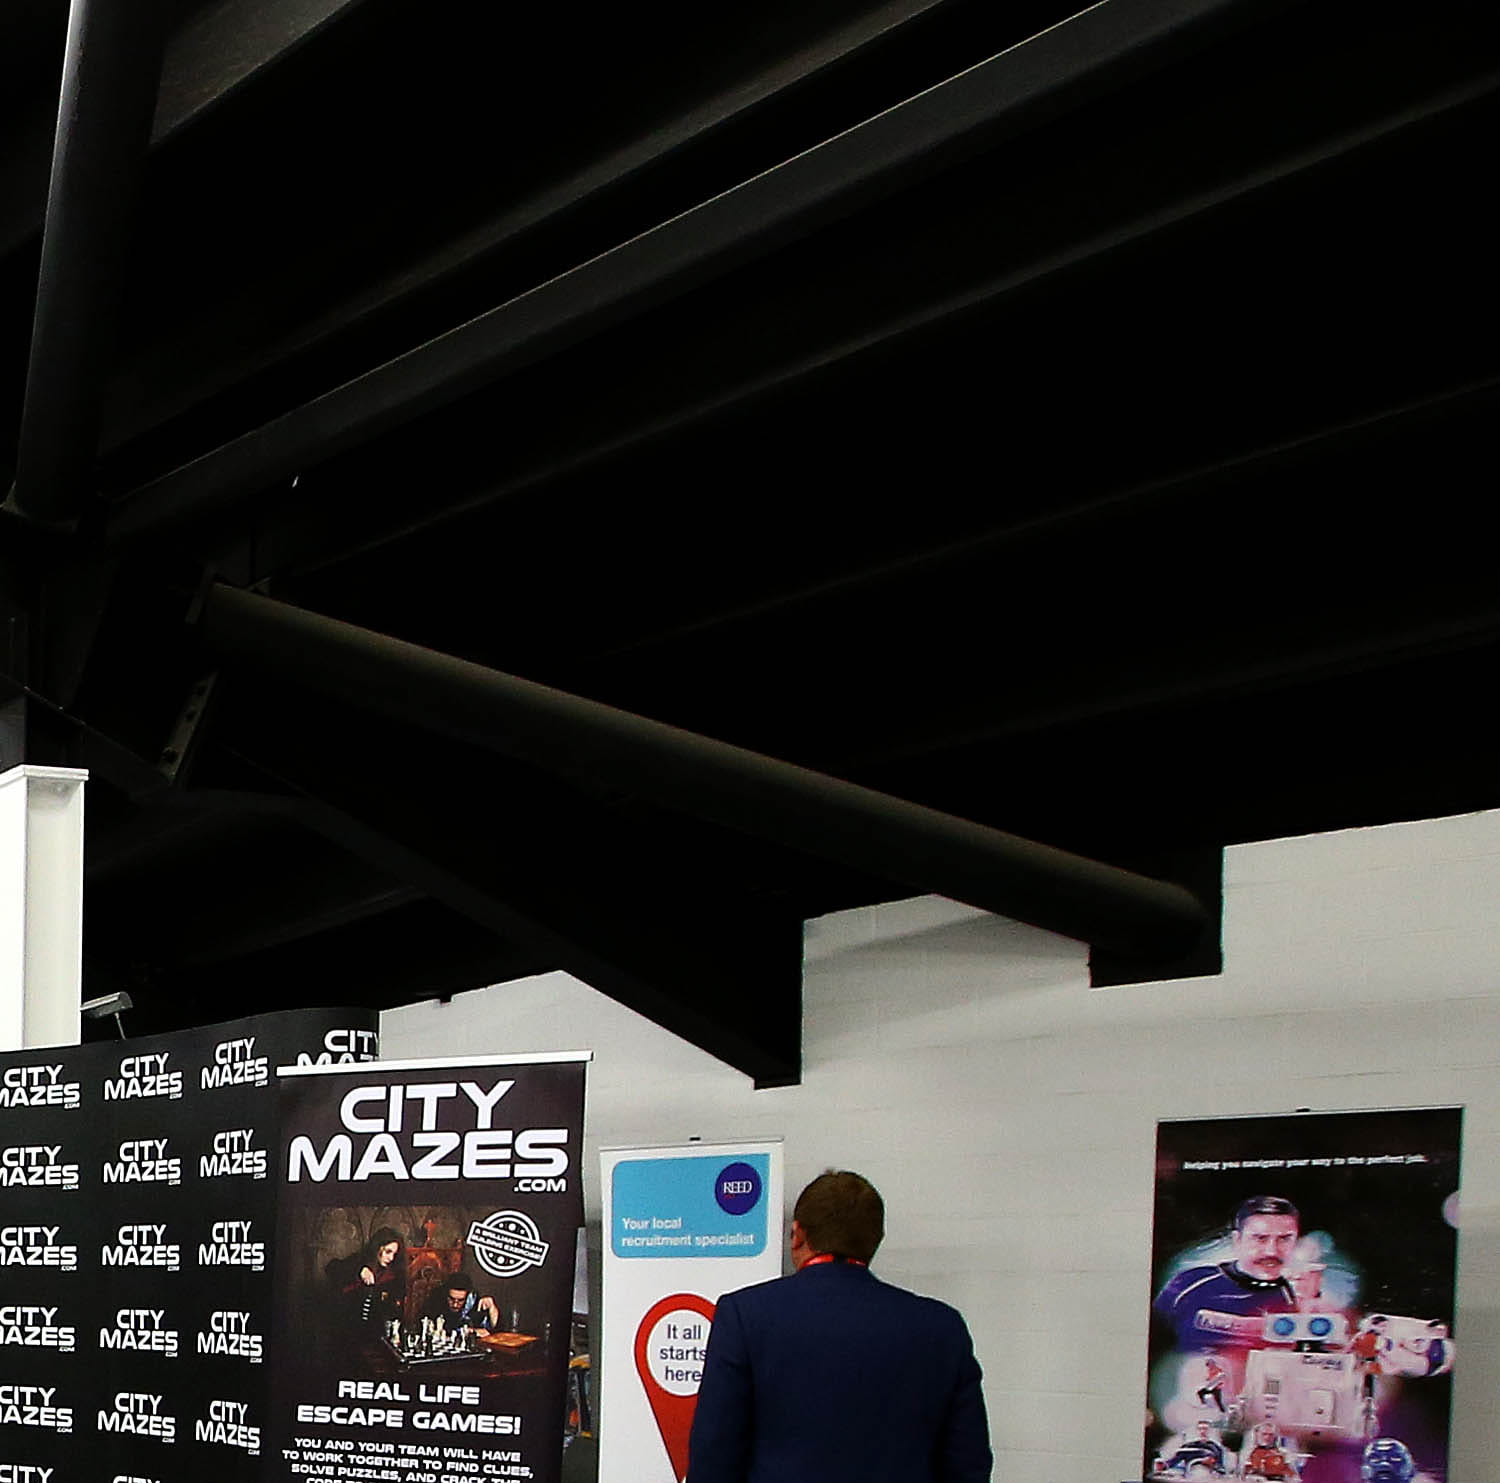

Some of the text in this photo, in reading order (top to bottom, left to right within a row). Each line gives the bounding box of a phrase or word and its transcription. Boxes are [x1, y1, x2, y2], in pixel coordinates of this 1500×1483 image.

[4, 1065, 62, 1087] CITY
[340, 1079, 516, 1134] CITY
[288, 1128, 569, 1182] MAZES
[1222, 1160, 1241, 1170] you
[1286, 1158, 1309, 1168] your
[1311, 1157, 1332, 1167] way
[1333, 1156, 1345, 1165] to
[1347, 1155, 1365, 1164] the
[1367, 1154, 1404, 1166] perfect
[513, 1178, 567, 1193] .COM
[723, 1180, 753, 1194] REED
[622, 1216, 682, 1230] Your local
[621, 1232, 755, 1247] recruitment specialist
[667, 1324, 702, 1340] It all
[659, 1345, 707, 1361] starts
[338, 1380, 481, 1405] REAL LIFE
[297, 1404, 522, 1435] ESCAPE GAMES!
[294, 1437, 521, 1462] YOU AND YOUR TEAM WILL HAVE
[282, 1449, 534, 1479] TO WORK TOGETHER TO FIND CLUES,
